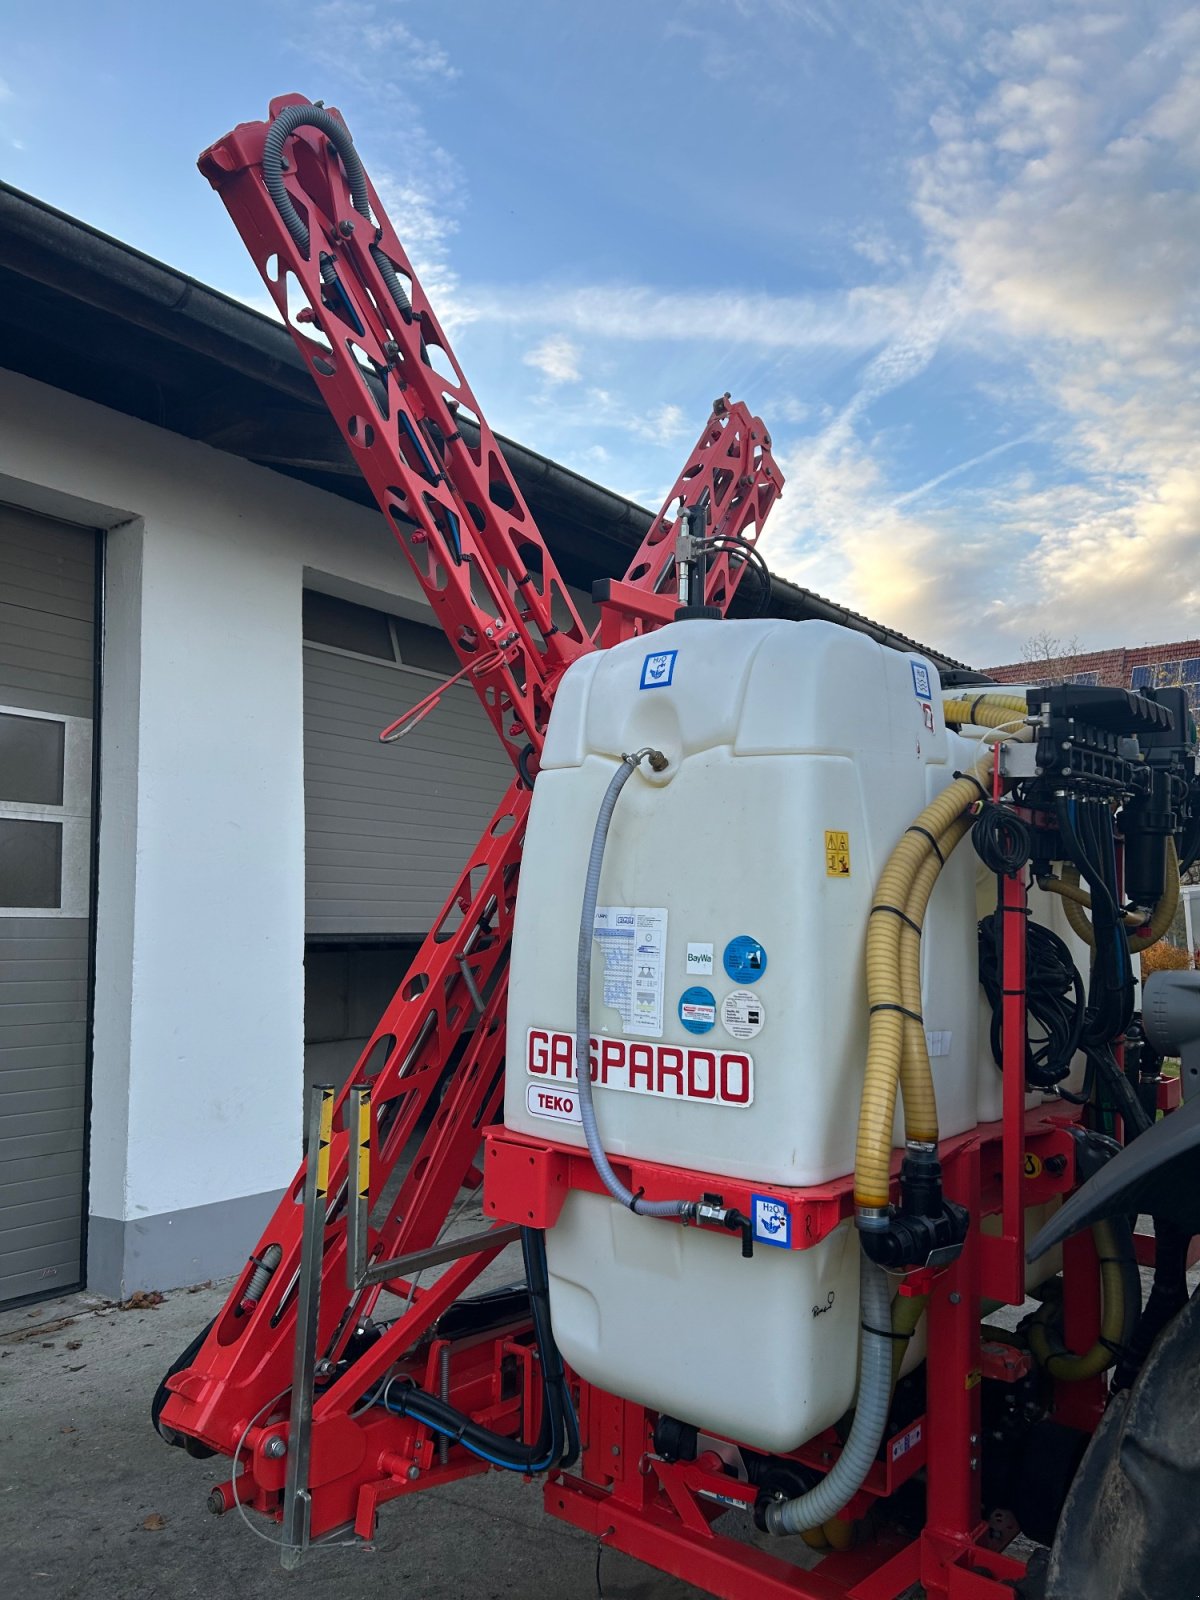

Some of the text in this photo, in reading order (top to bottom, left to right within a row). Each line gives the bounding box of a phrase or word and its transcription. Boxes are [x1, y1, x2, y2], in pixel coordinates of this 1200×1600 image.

[687, 953, 712, 963] BayWa
[538, 1093, 573, 1113] TEKO
[763, 1202, 779, 1213] H2O
